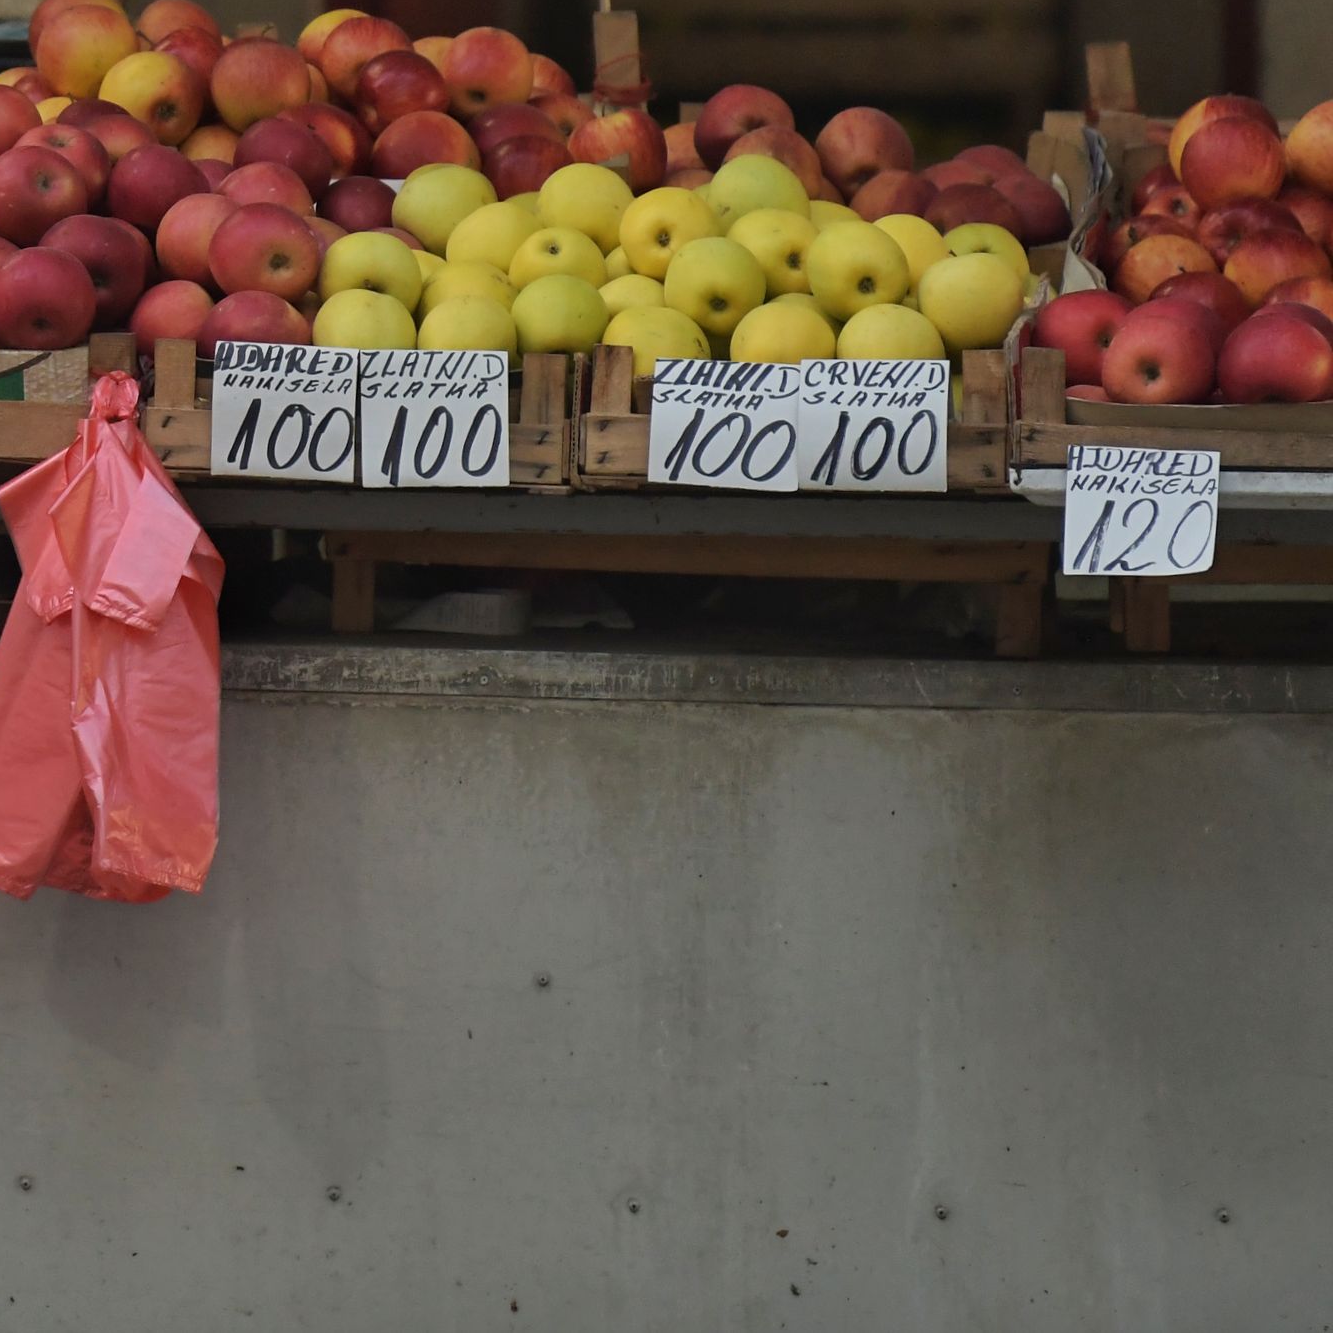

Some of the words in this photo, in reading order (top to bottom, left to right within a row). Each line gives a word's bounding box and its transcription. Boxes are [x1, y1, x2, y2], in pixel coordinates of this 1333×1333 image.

[215, 342, 353, 377] AJDARED
[361, 382, 488, 399] SLATKA
[653, 388, 764, 410] SLATKA
[803, 390, 927, 409] SLATKA
[227, 398, 354, 472] 100
[381, 403, 502, 487] 100
[664, 408, 796, 482] 100
[810, 409, 937, 486] 100
[1067, 445, 1213, 477] AJDARED
[1072, 498, 1213, 574] 120
